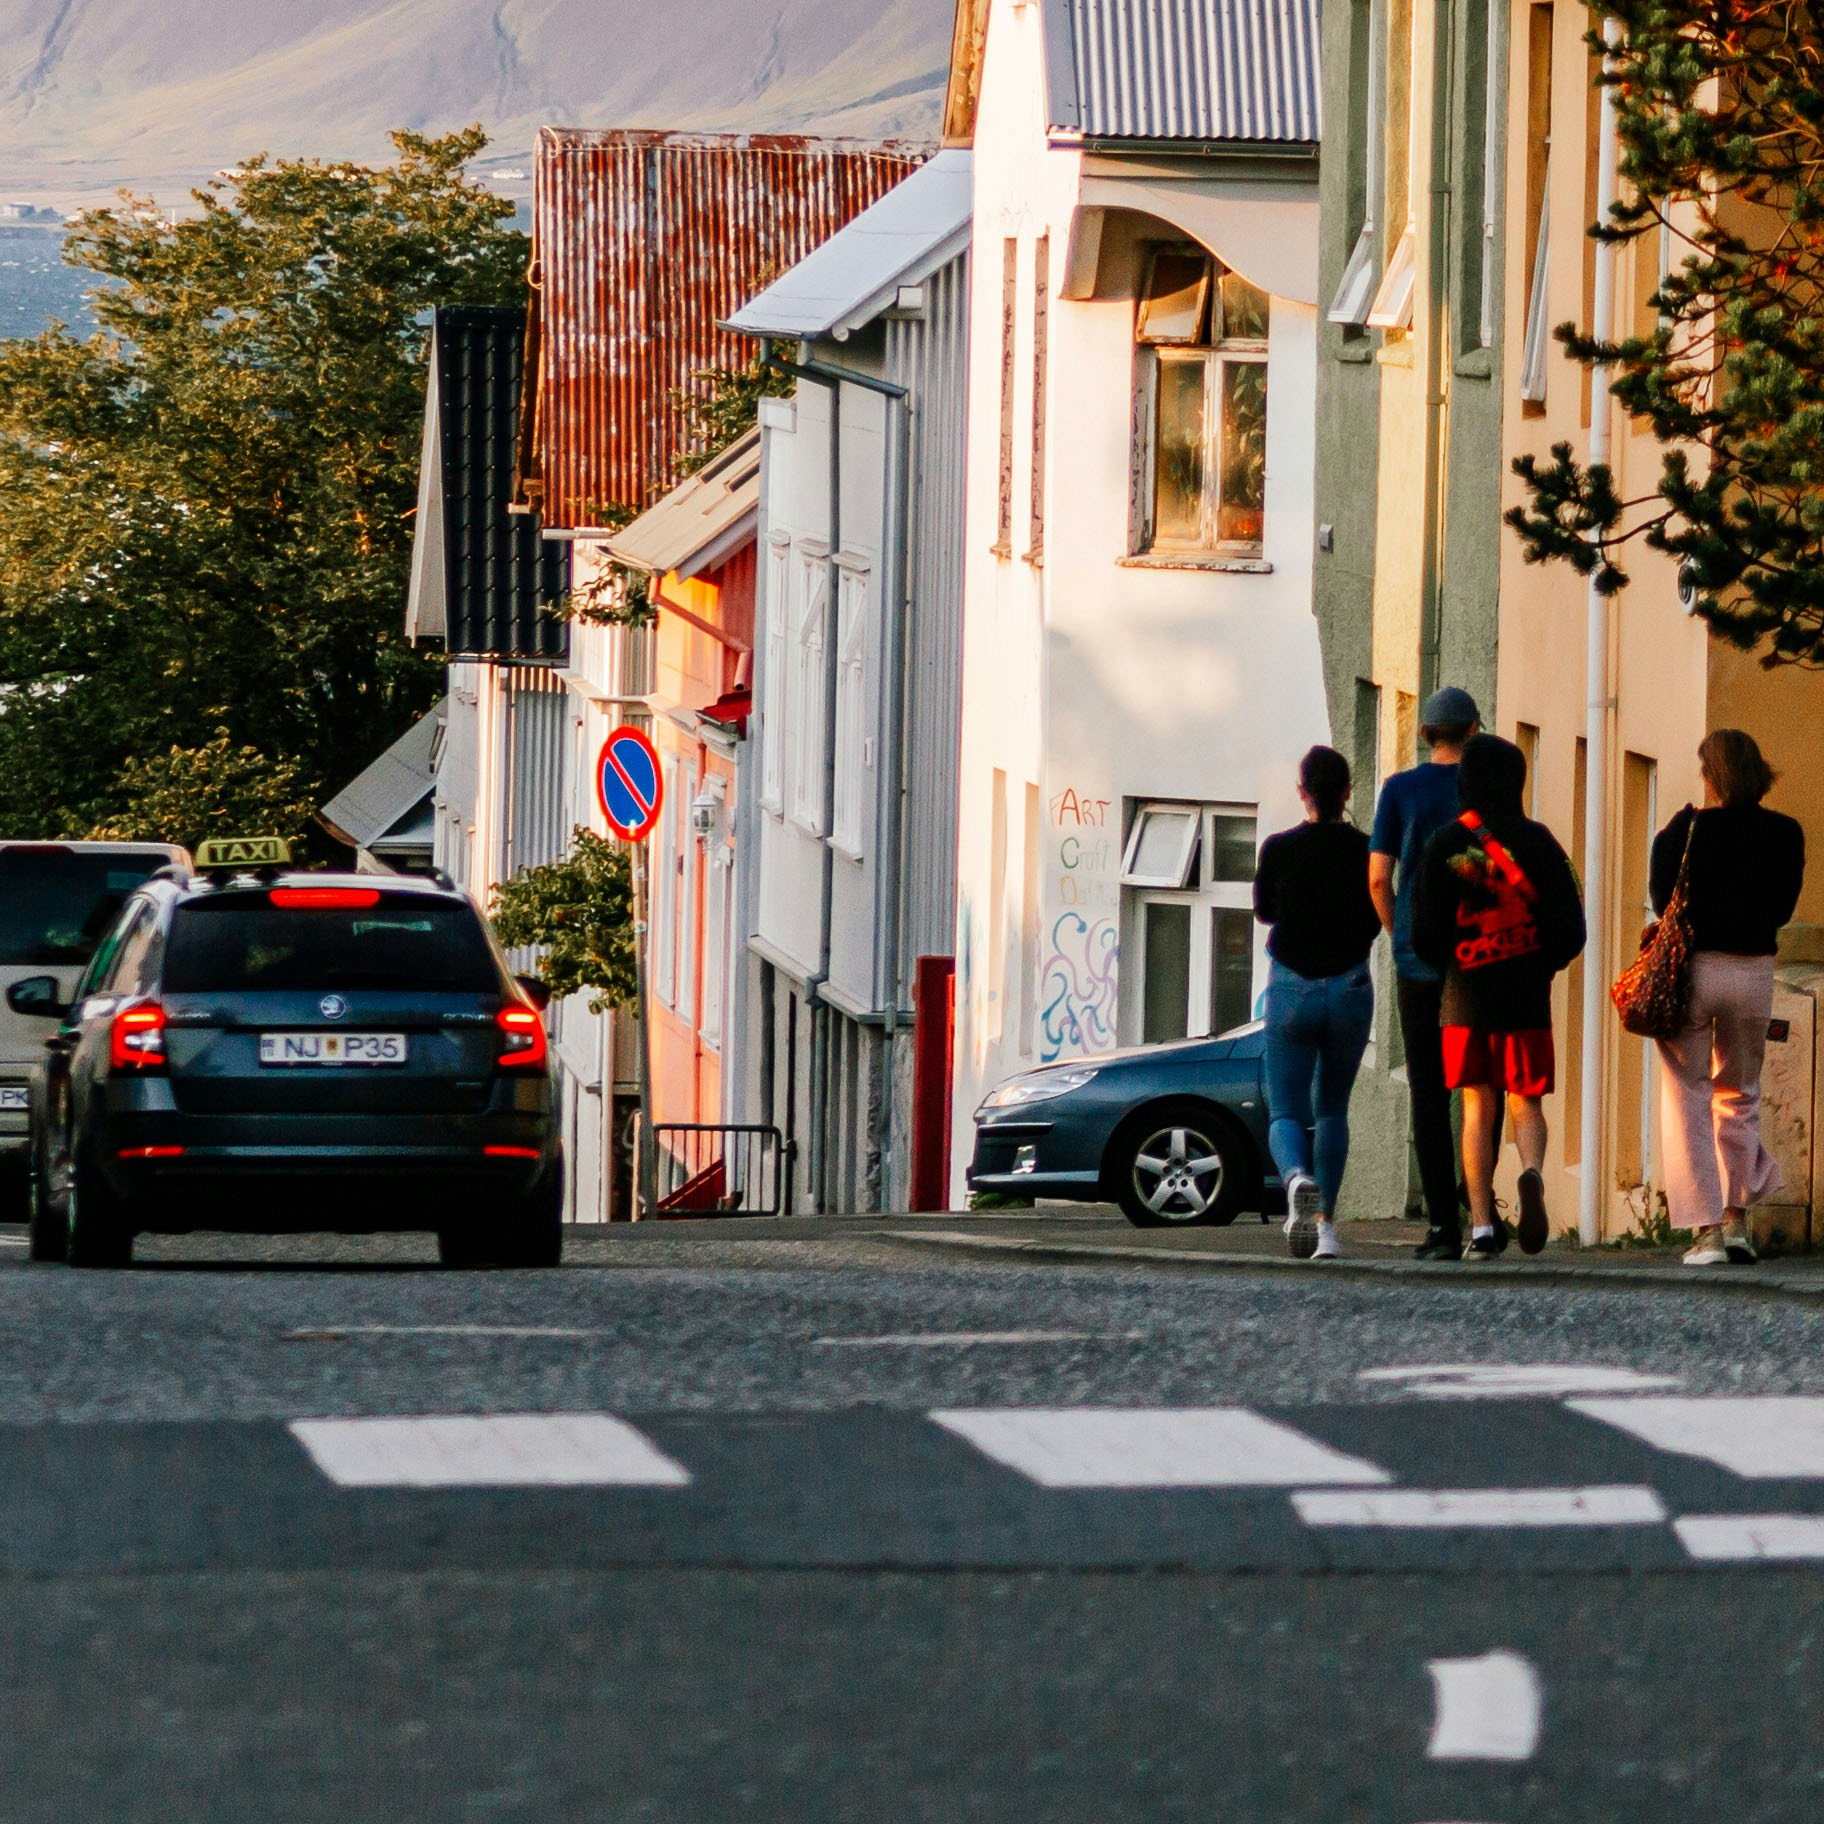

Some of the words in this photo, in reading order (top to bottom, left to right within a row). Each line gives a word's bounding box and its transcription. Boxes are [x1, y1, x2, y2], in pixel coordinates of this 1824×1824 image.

[210, 843, 277, 861] TAXI
[285, 1037, 320, 1058] NJ
[344, 1037, 399, 1058] P35
